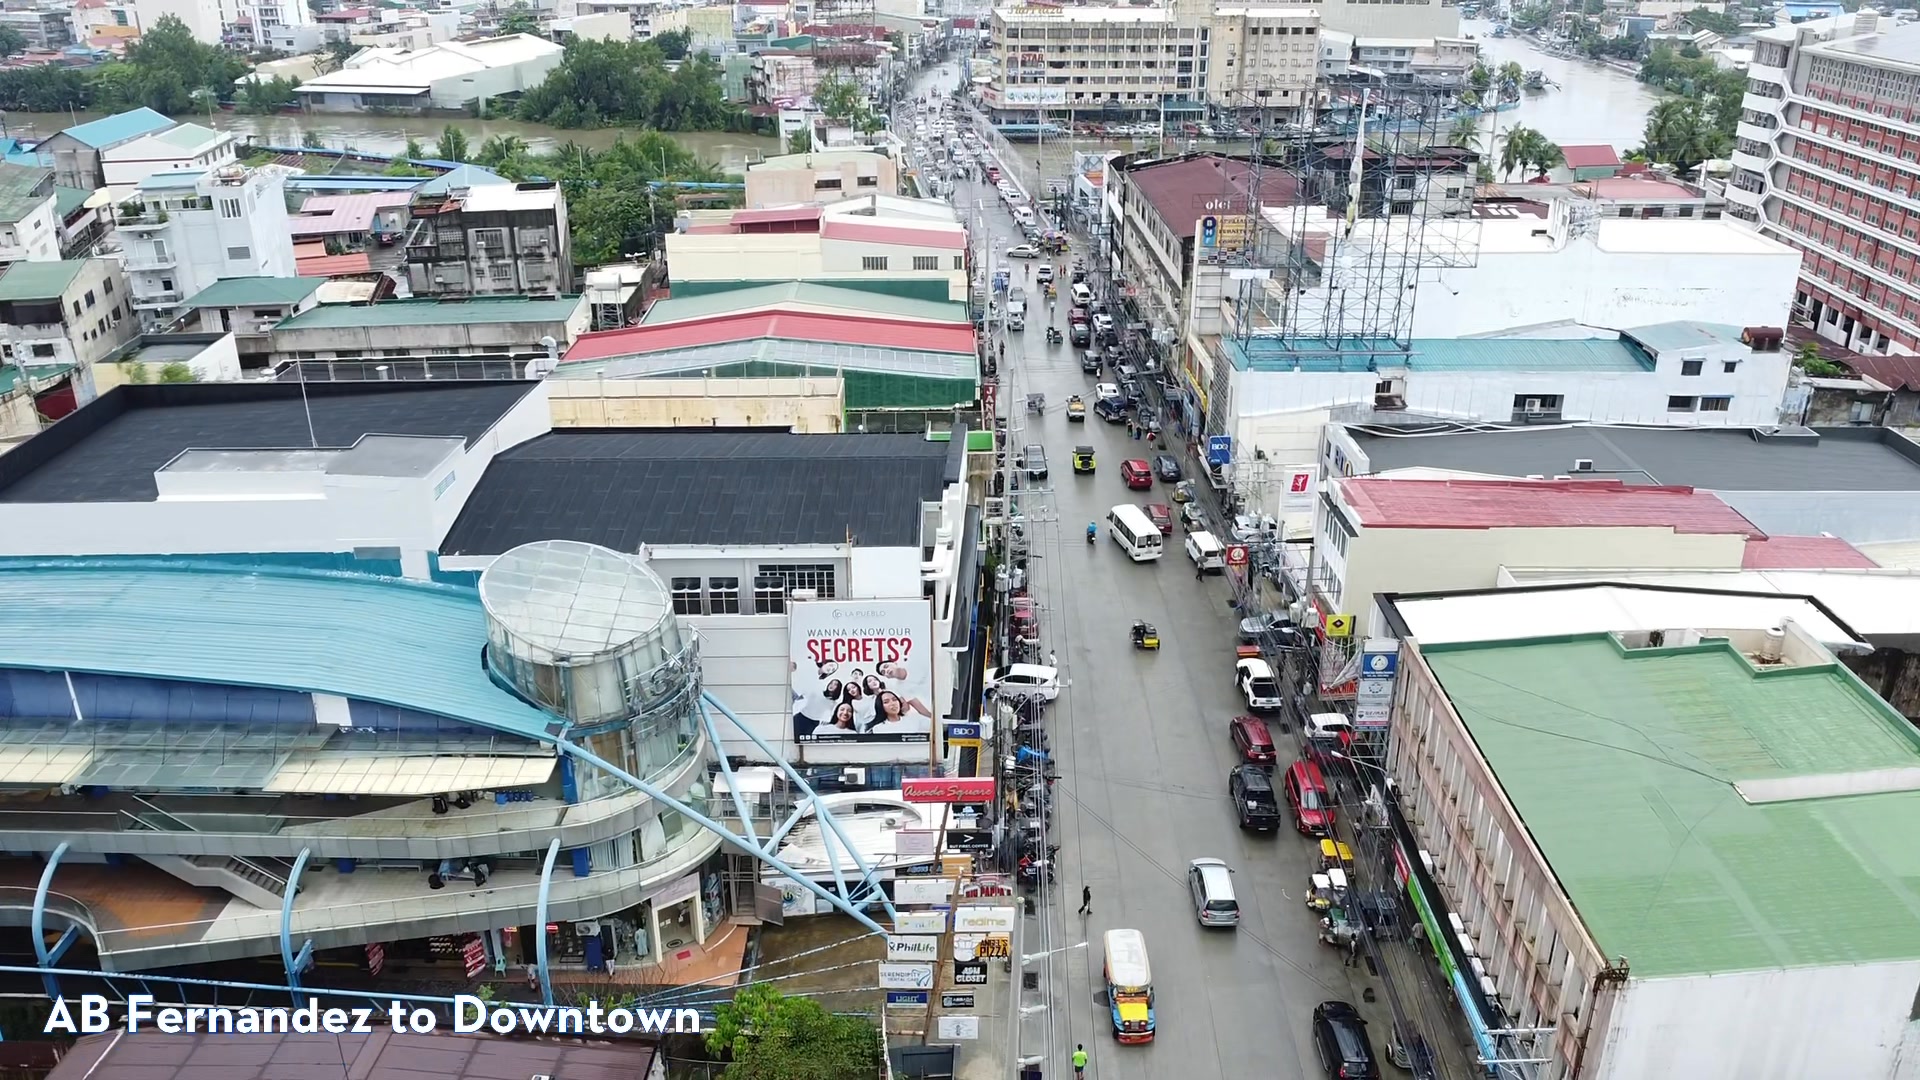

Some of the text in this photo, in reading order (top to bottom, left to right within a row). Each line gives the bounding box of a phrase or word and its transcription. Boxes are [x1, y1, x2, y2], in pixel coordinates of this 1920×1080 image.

[807, 628, 911, 637] WANNA KNOW OUR
[806, 637, 912, 663] SECRETS?
[953, 727, 974, 735] BDO
[947, 785, 992, 800] Square
[962, 916, 1007, 927] realme
[896, 942, 936, 953] PhilLife
[980, 946, 1008, 957] PIZZA
[956, 974, 987, 983] CLOSET
